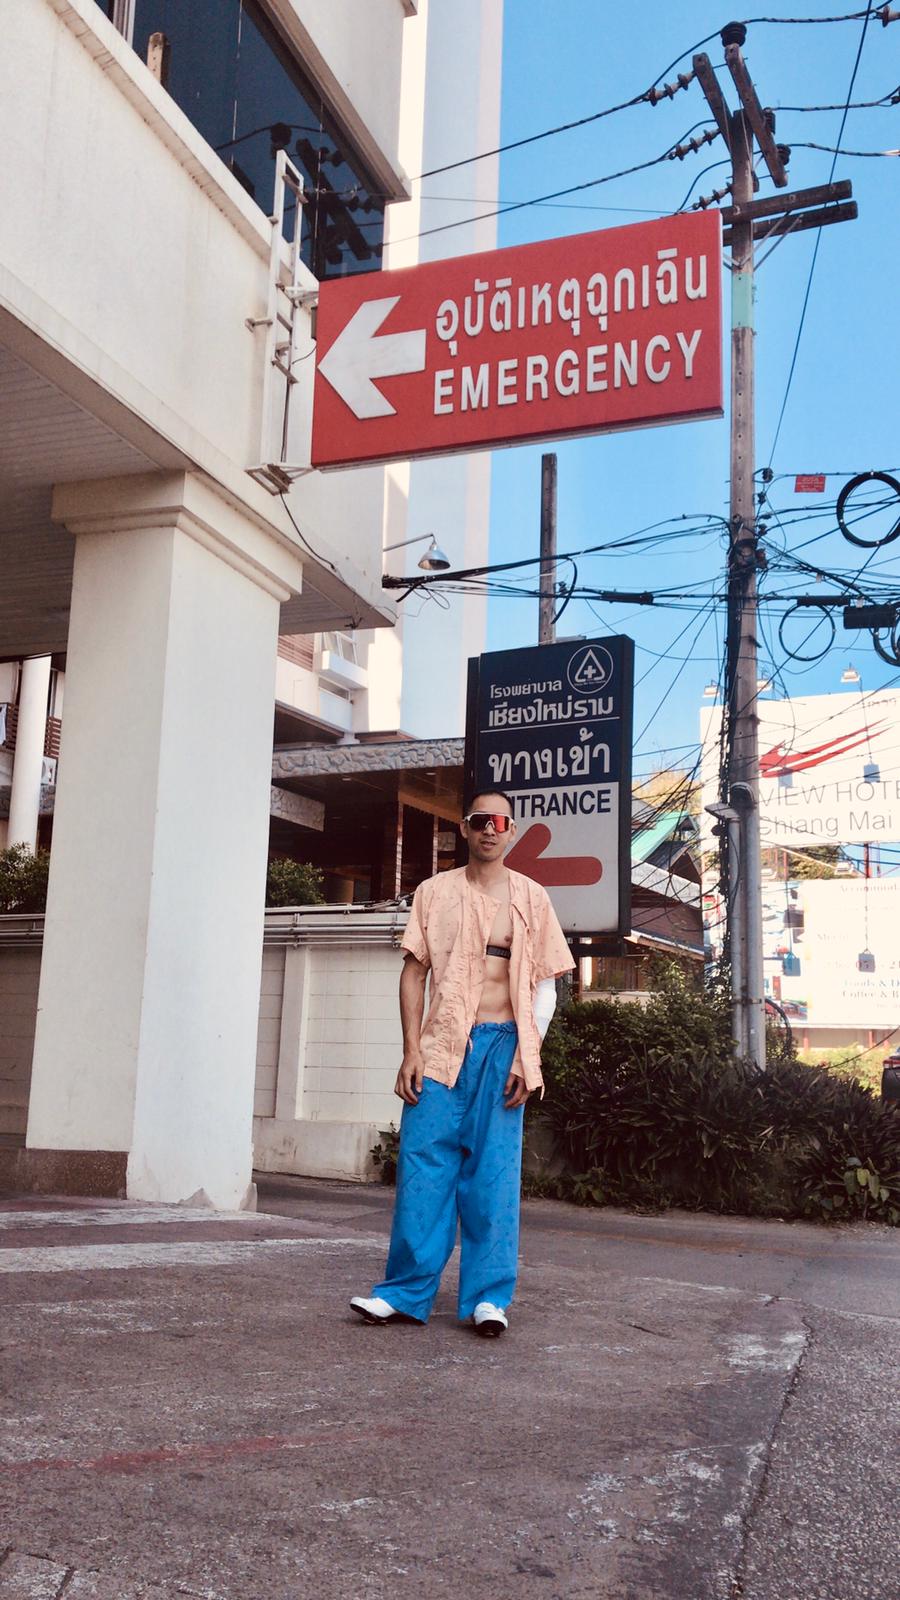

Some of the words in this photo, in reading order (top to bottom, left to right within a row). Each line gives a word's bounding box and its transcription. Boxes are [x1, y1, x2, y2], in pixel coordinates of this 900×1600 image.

[436, 247, 707, 356] อุบัติเหตุฉุกเฉิน
[434, 329, 702, 415] EMERGENCY
[490, 679, 562, 699] โรงพยาบาล
[488, 695, 614, 727] เชียงใหม่ราม
[488, 727, 611, 783] ทางเข้า
[510, 788, 612, 819] TRANCE
[759, 784, 827, 807] VIEW
[849, 809, 893, 831] Mai
